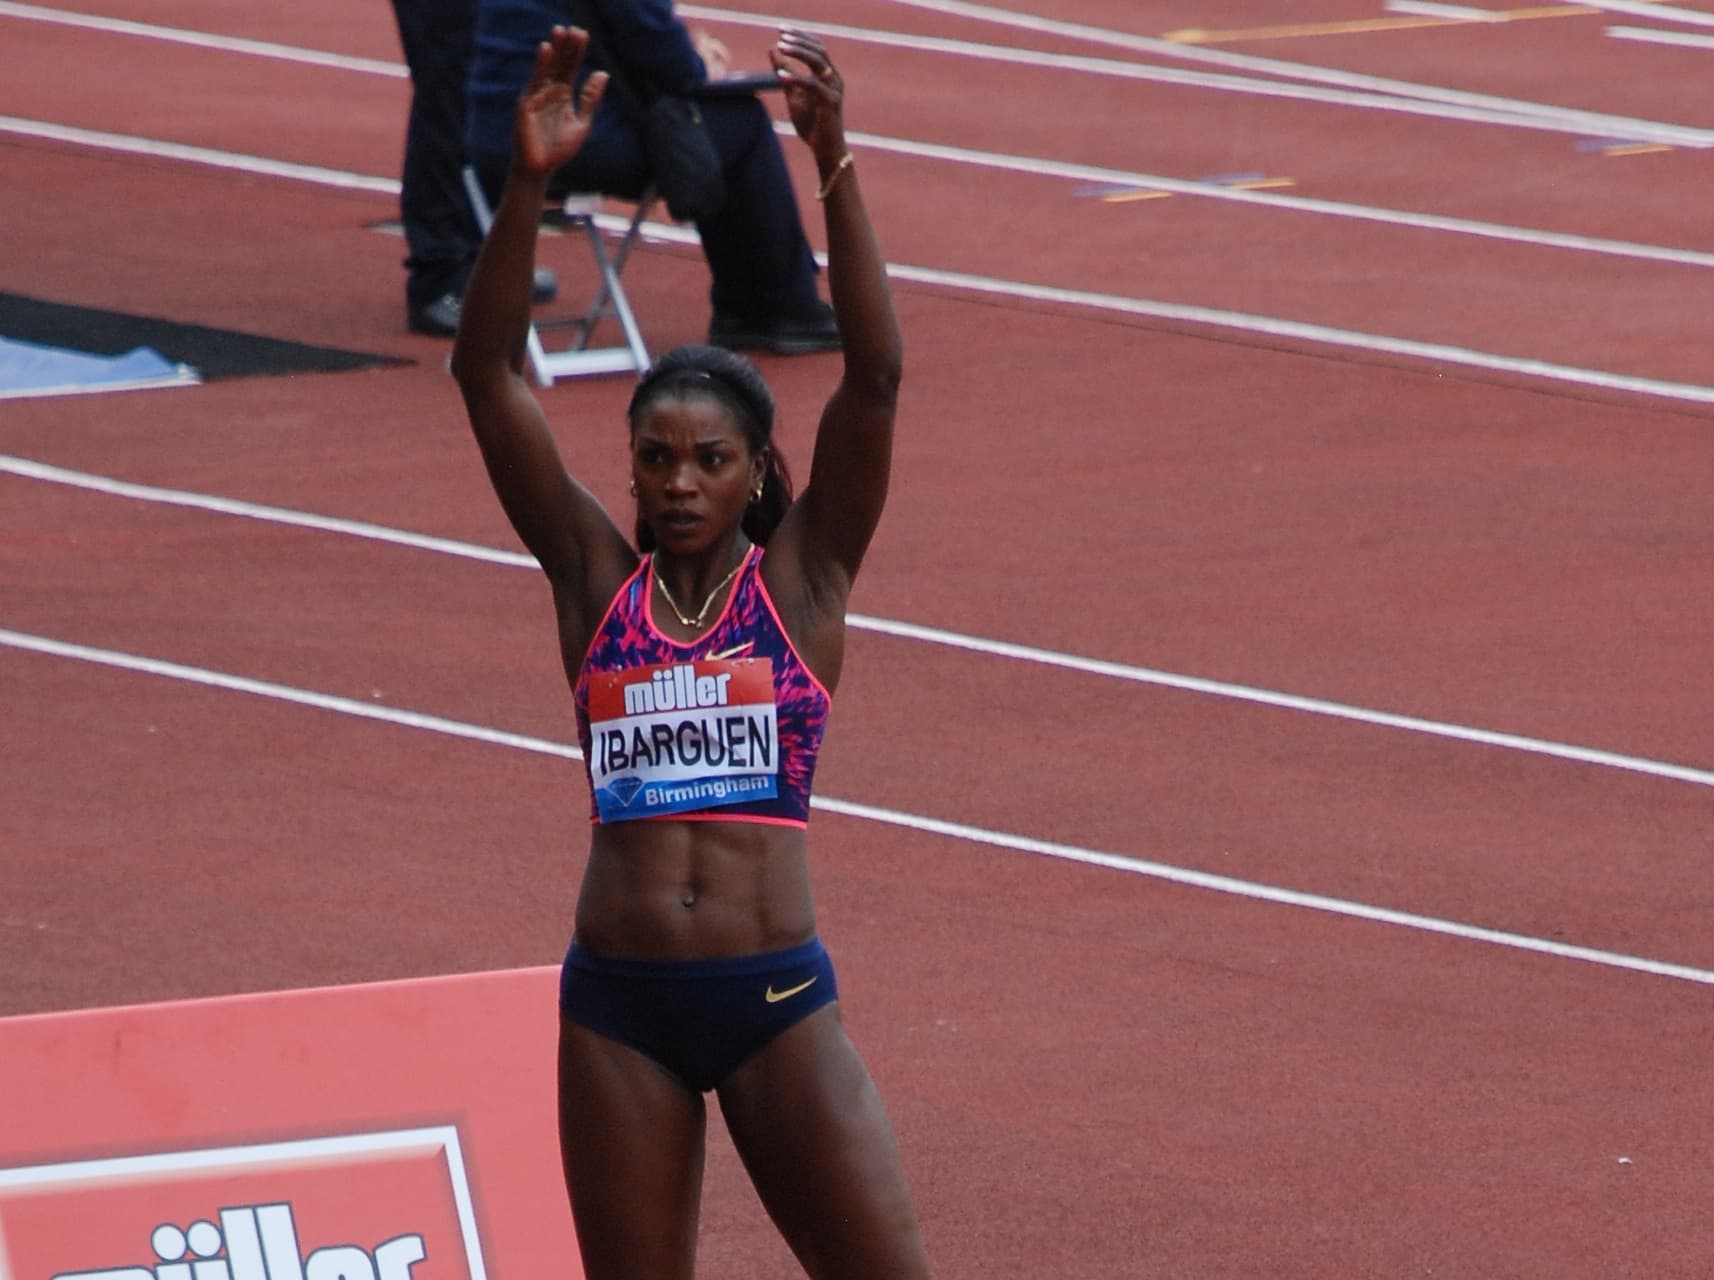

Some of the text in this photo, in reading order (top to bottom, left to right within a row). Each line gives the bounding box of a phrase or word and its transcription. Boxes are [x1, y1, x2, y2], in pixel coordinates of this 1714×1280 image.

[624, 664, 731, 714] müller
[600, 715, 771, 776] IBARGUEN
[645, 775, 769, 806] Birmingham
